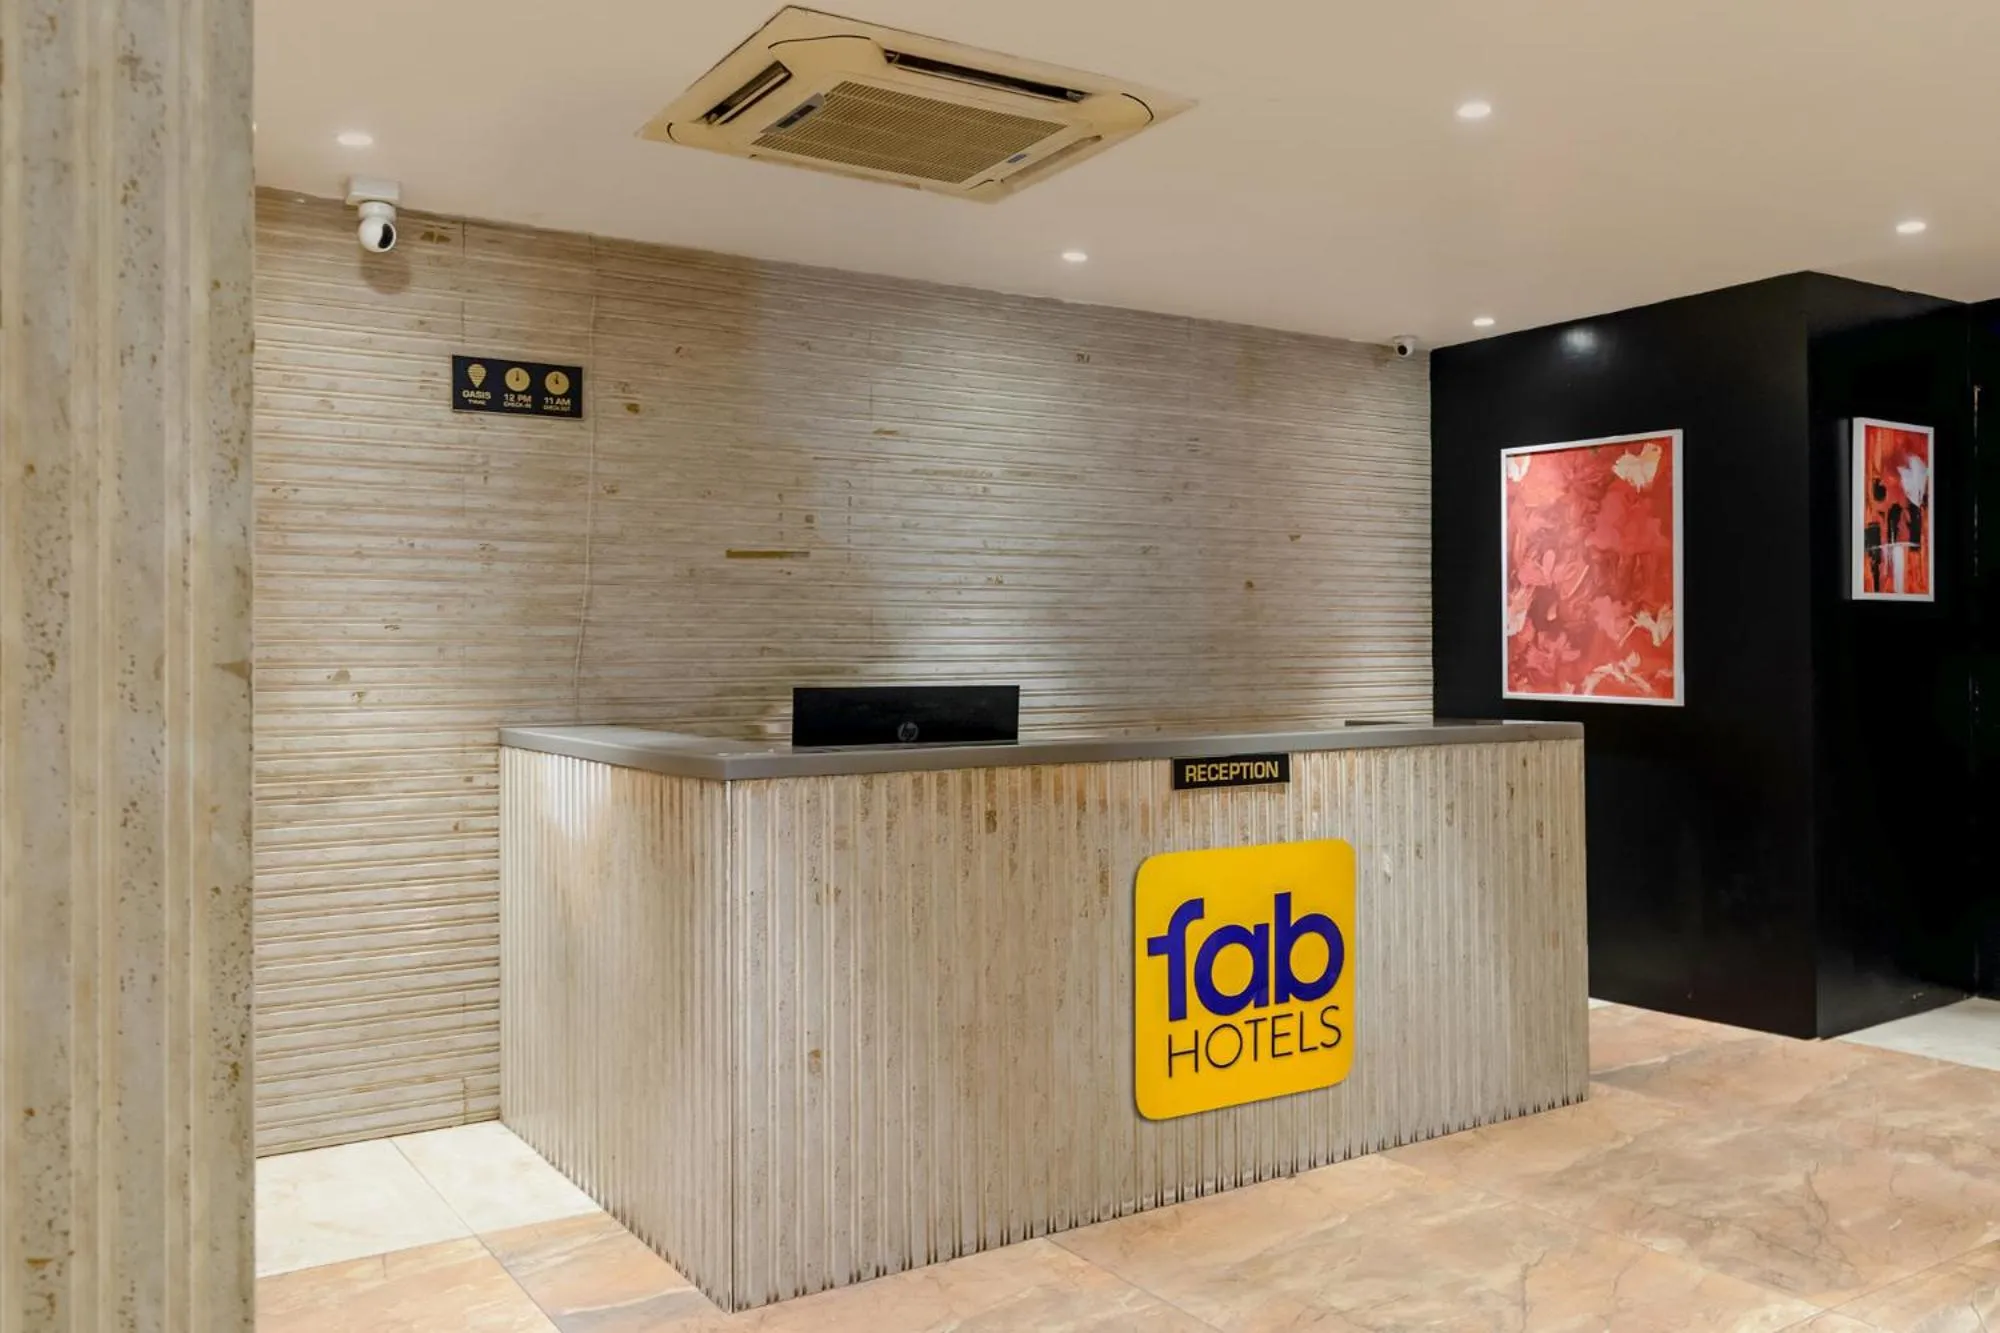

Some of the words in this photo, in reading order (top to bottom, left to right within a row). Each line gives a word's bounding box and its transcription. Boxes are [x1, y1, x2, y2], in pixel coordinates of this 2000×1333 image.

[462, 390, 491, 400] OASIS
[503, 393, 515, 402] 12
[517, 394, 532, 403] PM
[543, 396, 554, 405] 11
[556, 397, 572, 406] AM
[898, 721, 918, 741] hp
[1185, 761, 1279, 782] RECEPTION
[1147, 891, 1345, 1022] fab
[1168, 1005, 1342, 1078] HOTELS
